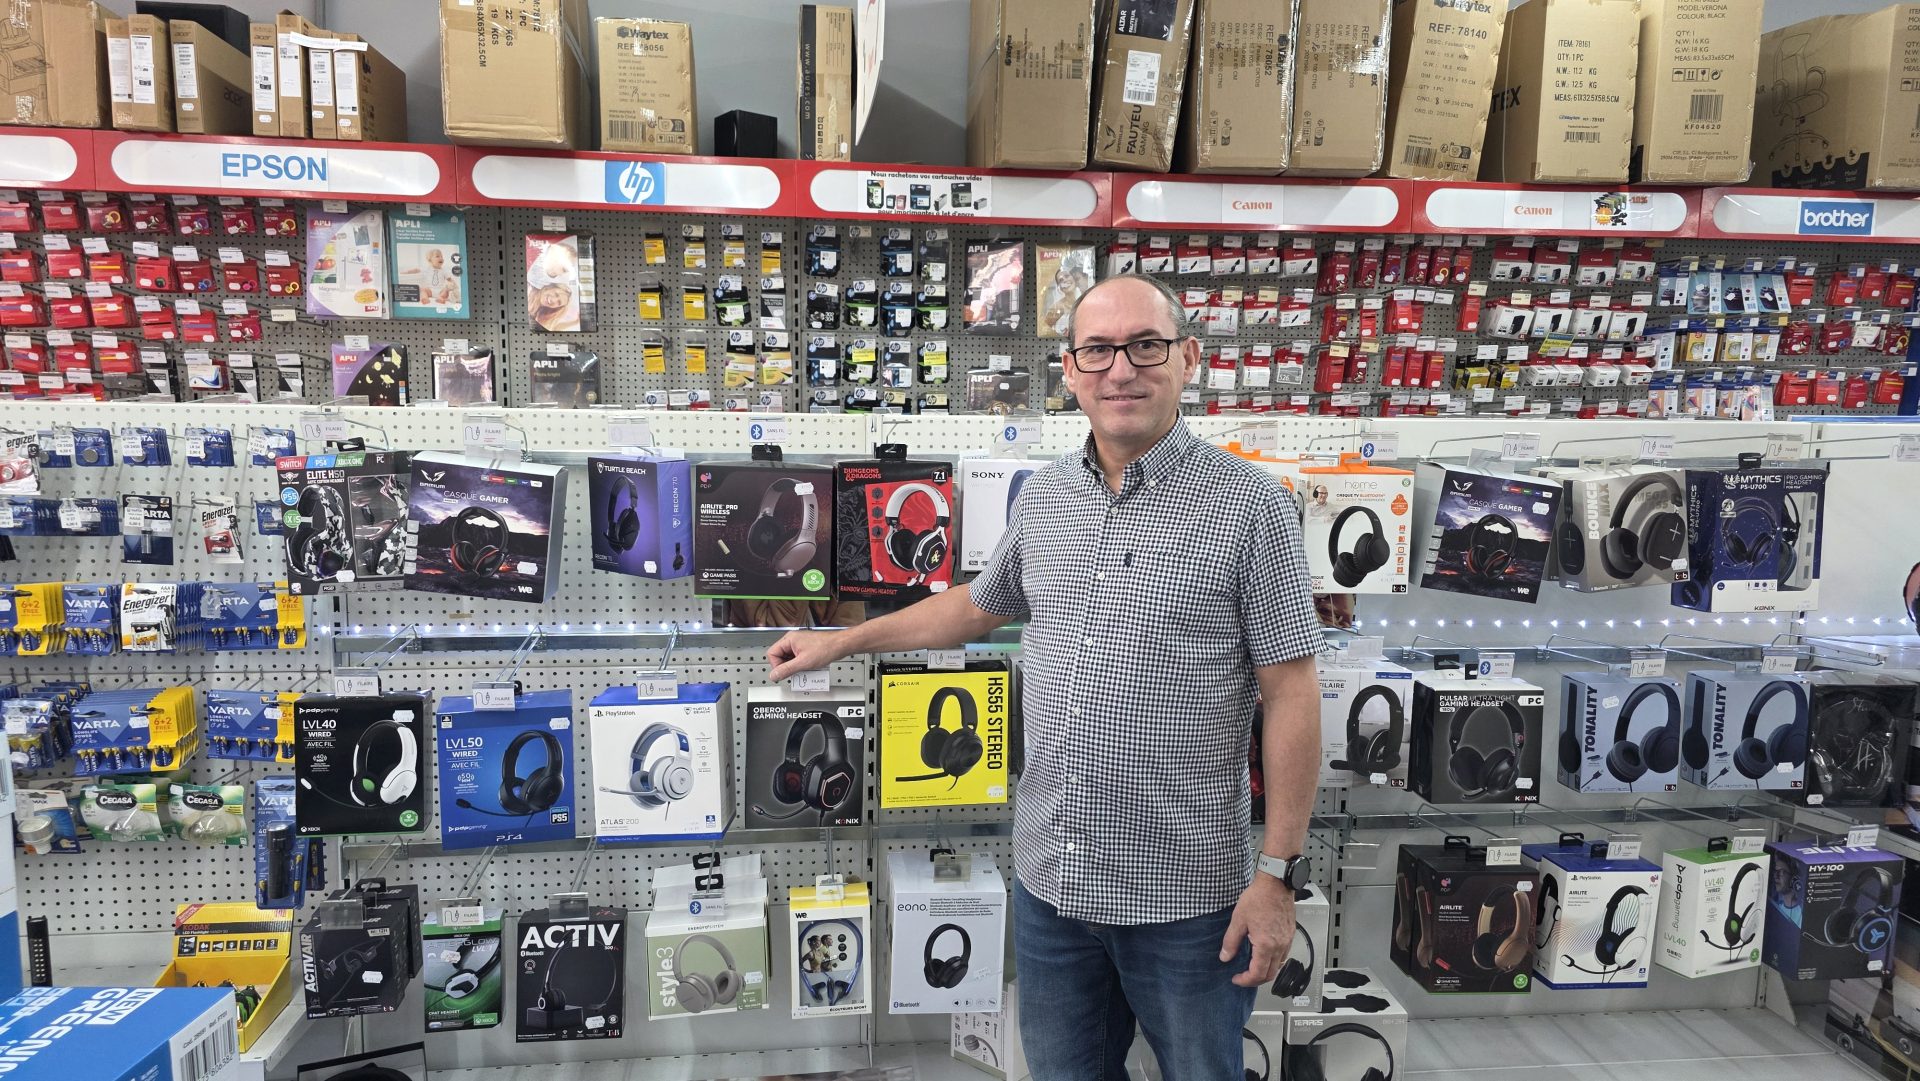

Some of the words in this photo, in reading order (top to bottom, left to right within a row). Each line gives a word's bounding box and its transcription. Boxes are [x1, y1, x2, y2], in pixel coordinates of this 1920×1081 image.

[1118, 9, 1128, 33] ALTAR
[1428, 23, 1455, 35] REF:
[1458, 26, 1488, 40] 78140
[1575, 40, 1591, 48] 78161
[1264, 48, 1273, 77] 78052
[1572, 80, 1584, 88] 12.5
[221, 152, 327, 182] EPSON
[870, 170, 887, 178] Nous
[887, 171, 919, 179] rachetons
[931, 173, 966, 181] cartouches
[966, 174, 983, 182] vides
[624, 161, 652, 205] hp
[1232, 200, 1273, 212] Canon
[1513, 205, 1553, 216] Canon
[1803, 208, 1870, 228] brother
[313, 219, 332, 228] APLI
[395, 219, 421, 229] APLI
[967, 245, 989, 253] APLI
[338, 354, 358, 362] APLI
[433, 355, 456, 364] APLI
[533, 360, 558, 369] APLI
[970, 374, 993, 383] APLI
[376, 455, 385, 464] PC
[306, 470, 327, 480] ELITE
[329, 469, 345, 479] H50
[604, 465, 625, 473] TURTLE
[626, 467, 646, 475] BEACH
[971, 471, 1004, 479] SONY
[672, 477, 678, 485] 70
[933, 471, 947, 481] 7.1
[1740, 474, 1782, 484] MYTHICS
[1344, 479, 1378, 490] home
[1740, 483, 1767, 491] PS-U700
[282, 493, 298, 501] PS5
[443, 490, 478, 500] CASQUE
[479, 495, 509, 504] GAMER
[1600, 481, 1611, 519] MAX
[1468, 498, 1497, 509] CASQUE
[1498, 503, 1523, 513] GAMER
[1689, 483, 1698, 528] MYTHICS
[1723, 500, 1735, 510] 7.1
[202, 505, 234, 522] Energizer
[700, 508, 731, 516] WIRELESS
[1584, 481, 1600, 541] BOUNCE
[840, 585, 860, 593] RAINBOW
[21, 600, 40, 608] 6+2
[66, 600, 108, 609] VARTA
[122, 595, 170, 611] Energizer
[280, 595, 299, 604] 6+2
[987, 677, 1003, 713] HS55
[1527, 697, 1542, 705] PC
[209, 705, 251, 717] VARTA
[753, 706, 787, 714] OBERON
[847, 708, 863, 717] PC
[753, 712, 785, 720] GAMING
[786, 712, 823, 720] HEADSET
[1584, 685, 1599, 753] TONALITY
[1712, 682, 1728, 750] TONALITY
[73, 719, 121, 730] VARTA
[153, 717, 173, 727] 6+2
[302, 719, 337, 729] LVL40
[445, 736, 484, 749] LVL50
[987, 717, 1003, 770] STEREO
[451, 750, 478, 758] WIRED
[100, 795, 133, 805] CEGASA
[186, 794, 219, 806] CEGASA
[551, 812, 568, 823] PS5
[835, 817, 859, 825] KONIX
[496, 833, 523, 842] PS4
[1808, 864, 1845, 873] HY-100
[1703, 877, 1725, 888] LVL40
[520, 923, 621, 950] ACTIV
[1663, 934, 1687, 947] LVL40
[301, 933, 318, 994] ACTIVAIR
[656, 946, 681, 1008] style3
